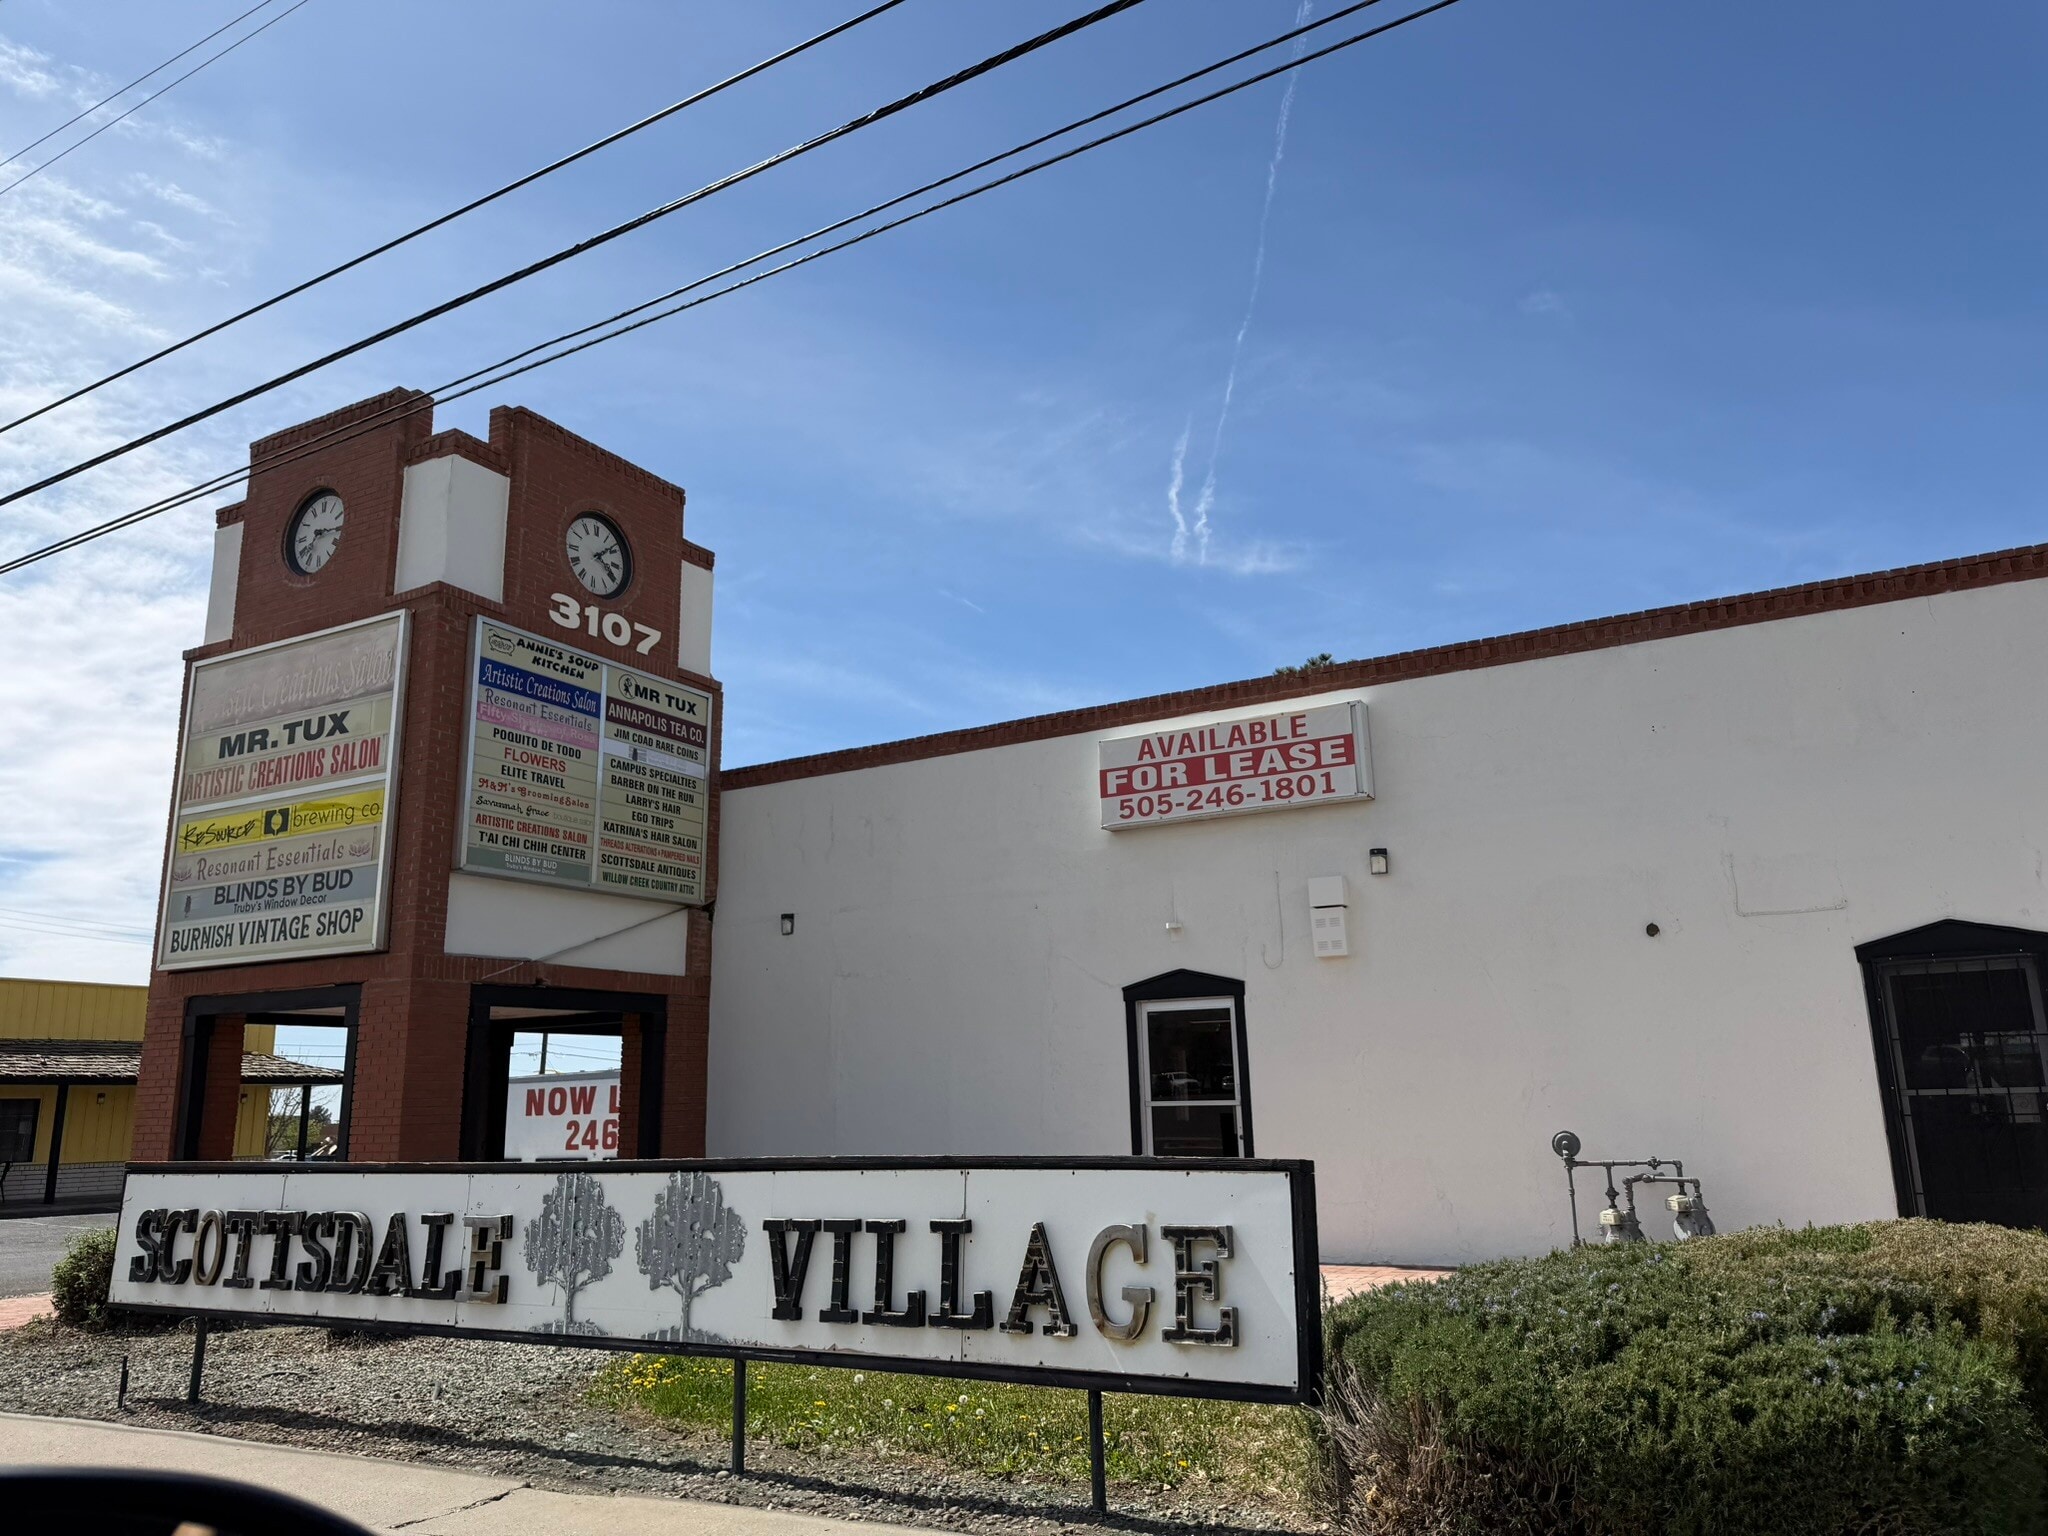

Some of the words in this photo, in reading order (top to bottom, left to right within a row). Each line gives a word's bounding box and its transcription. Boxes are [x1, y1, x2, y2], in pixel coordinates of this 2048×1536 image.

[549, 592, 662, 656] 3107
[516, 638, 564, 660] ANNIE'S
[568, 655, 598, 671] SOUP
[532, 656, 584, 679] KITCHEN
[482, 664, 524, 691] Artistic
[526, 676, 570, 705] Creations
[572, 690, 596, 712] Salon
[634, 684, 660, 704] MR
[665, 694, 697, 715] TUX
[485, 688, 537, 715] Resonant
[541, 704, 592, 732] Essentials
[608, 703, 667, 732] ANNAPOLIS
[670, 721, 687, 738] TEA
[690, 727, 704, 744] CO.
[283, 710, 350, 745] TUX
[1137, 714, 1308, 762] AVAILABLE
[493, 728, 538, 748] POQUITO
[541, 740, 553, 752] DE
[557, 744, 581, 759] TODO
[614, 728, 629, 740] JIM
[632, 733, 653, 747] COAD
[656, 740, 674, 753] RARE
[676, 746, 699, 760] COINS
[183, 763, 244, 801] ARTISTIC
[250, 748, 325, 790] CREATIONS
[330, 738, 381, 775] SALON
[504, 747, 566, 772] FLOWERS
[610, 758, 647, 776] CAMPUS
[649, 769, 697, 789] SPECIALTIES
[1106, 761, 1188, 795] FOR
[1204, 738, 1347, 782] LEASE
[501, 764, 528, 780] ELITE
[531, 771, 565, 789] TRAVEL
[611, 775, 644, 792] BARBER
[647, 784, 659, 795] ON
[661, 787, 676, 800] THE
[678, 791, 694, 804] RUN
[476, 796, 523, 814] Savannah
[626, 794, 660, 810] LARRY'S
[662, 803, 681, 815] HAIR
[1119, 772, 1336, 820] 505-246-1801
[293, 805, 355, 827] brewing
[361, 802, 383, 818] co.
[476, 813, 514, 830] ARTISTIC
[516, 821, 560, 839] CREATIONS
[562, 830, 588, 844] SALON
[632, 811, 648, 823] EGO
[651, 815, 674, 829] TRIPS
[479, 831, 498, 844] T'AI
[502, 835, 520, 848] CHI
[523, 839, 548, 853] CHIH
[551, 844, 586, 860] CENTER
[603, 821, 648, 840] KATRINA'S
[651, 831, 670, 844] HAIR
[672, 836, 697, 850] SALON
[197, 851, 260, 880] Resonant
[266, 839, 344, 871] Essentials
[505, 853, 530, 865] BLINDS
[532, 858, 542, 866] BY
[543, 860, 557, 869] BUD
[600, 838, 624, 850] THREADS
[625, 842, 657, 858] ALTERATIONS
[661, 849, 686, 862] PAMPERED
[686, 854, 700, 865] NAILS
[601, 854, 655, 872] SCOTTSDALE
[657, 864, 696, 880] ANTIQUES
[213, 880, 278, 905] BLINDS
[282, 875, 310, 896] BY
[312, 869, 353, 892] BUD
[602, 871, 628, 885] WILLOW
[630, 876, 650, 888] CREEK
[651, 879, 678, 892] COUNTRY
[679, 885, 694, 895] ATTIC
[233, 902, 262, 914] Truby's
[264, 898, 297, 910] Window
[300, 894, 327, 905] Decor
[170, 923, 234, 953] BURNISH
[239, 914, 312, 946] VINTAGE
[316, 907, 363, 936] SHOP
[526, 1086, 597, 1116] NOW
[128, 1207, 514, 1305] SCOTTSDALE
[762, 1218, 1240, 1348] VILLAGE
